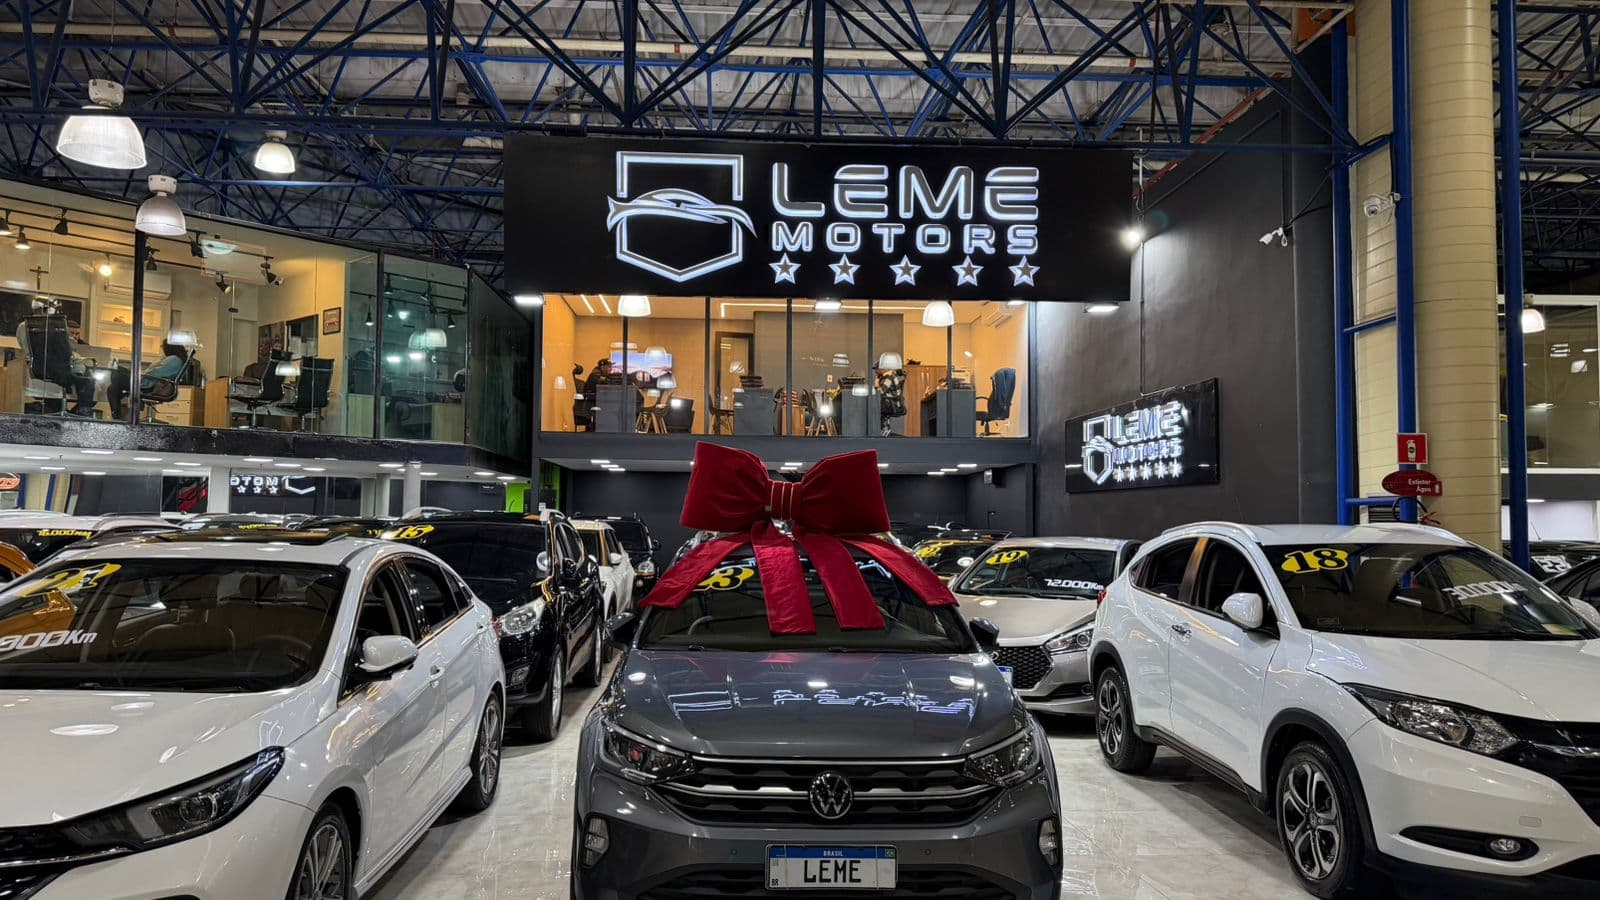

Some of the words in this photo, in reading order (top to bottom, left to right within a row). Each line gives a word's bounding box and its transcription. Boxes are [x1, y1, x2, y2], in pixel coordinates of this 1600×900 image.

[772, 161, 1040, 221] LEME
[772, 221, 1039, 255] MOTORS
[1111, 400, 1184, 445] LEME
[990, 550, 1025, 564] 19
[1283, 548, 1349, 573] 18
[694, 564, 748, 592] 3
[803, 859, 862, 884] LEME
